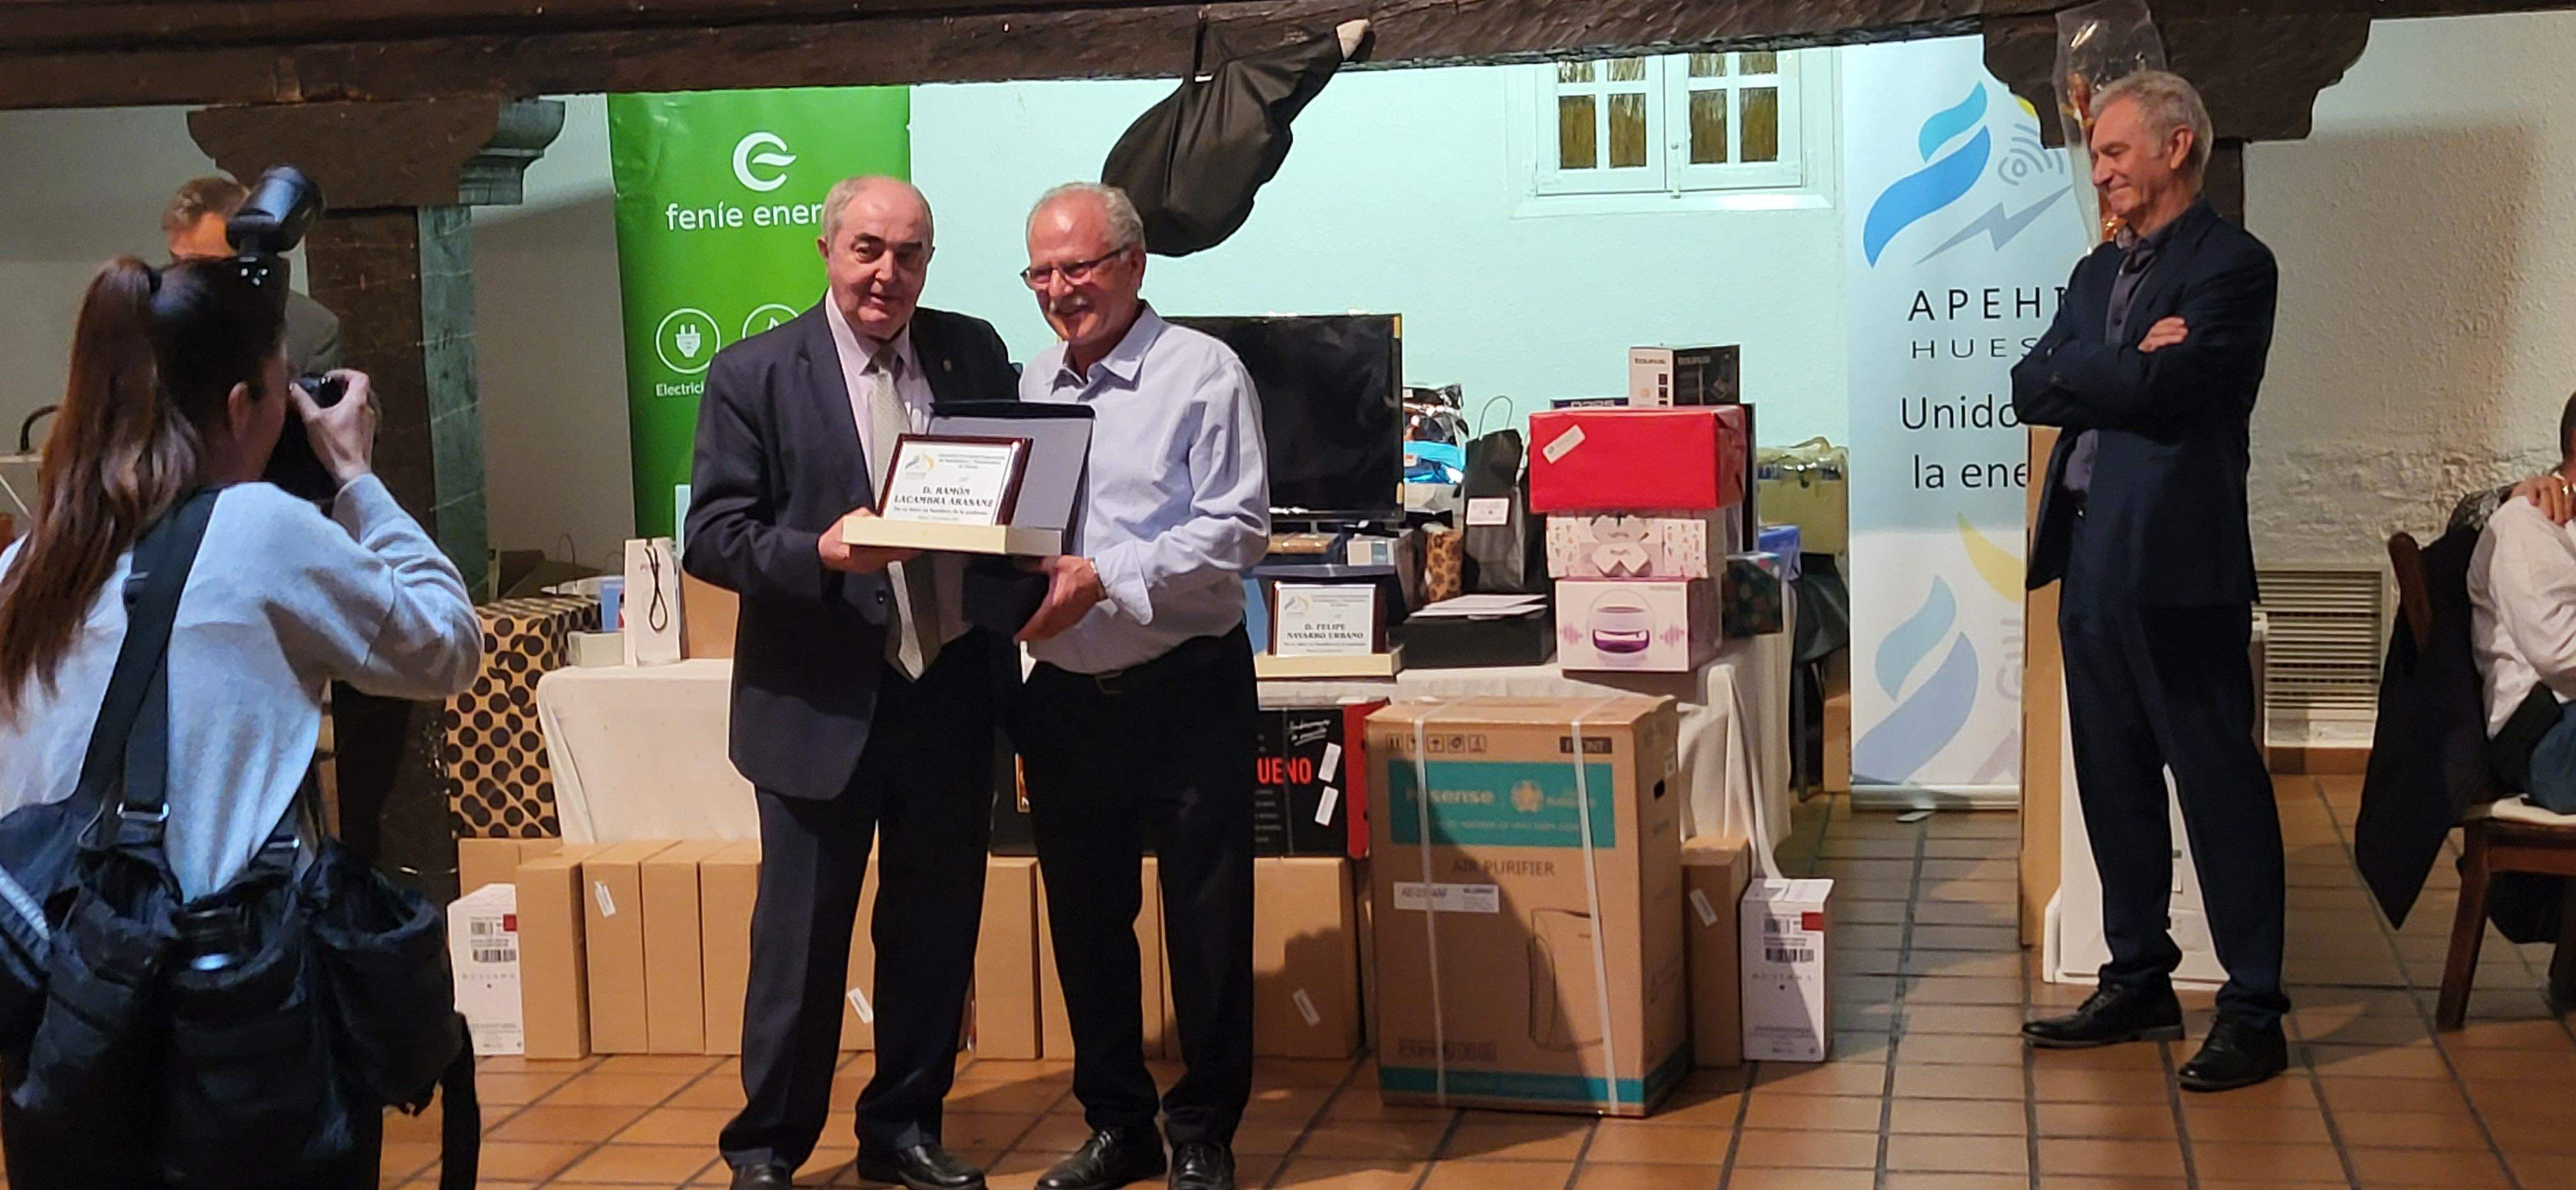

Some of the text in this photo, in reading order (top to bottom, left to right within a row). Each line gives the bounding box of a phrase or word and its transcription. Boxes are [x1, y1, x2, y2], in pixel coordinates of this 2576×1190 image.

[666, 202, 822, 231] feníe ener
[1902, 393, 2018, 429] Unido
[1915, 455, 2025, 489] la ene
[1484, 860, 1555, 876] PURIFIER
